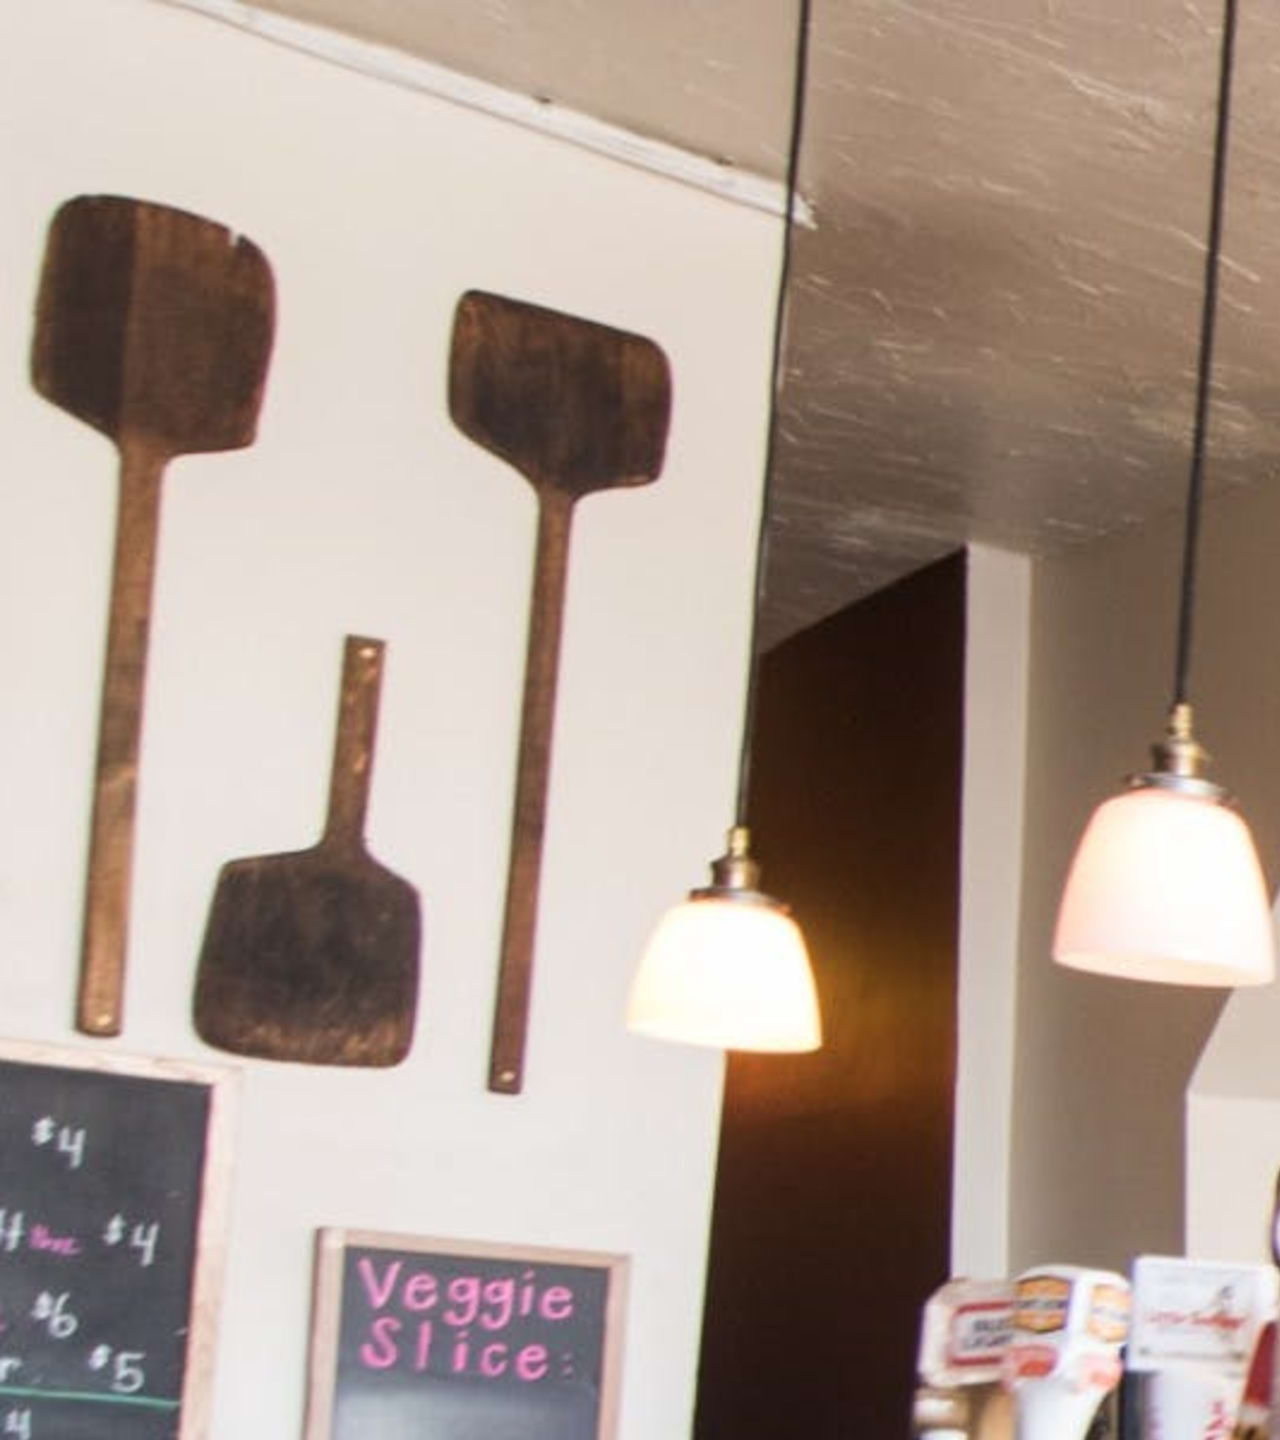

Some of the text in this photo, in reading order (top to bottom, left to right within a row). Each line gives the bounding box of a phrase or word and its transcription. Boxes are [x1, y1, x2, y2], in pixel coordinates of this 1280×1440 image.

[30, 1116, 85, 1169] $4
[102, 1214, 160, 1267] $4
[30, 1290, 78, 1339] $6
[357, 1257, 575, 1330] Veggie
[88, 1344, 146, 1393] $5
